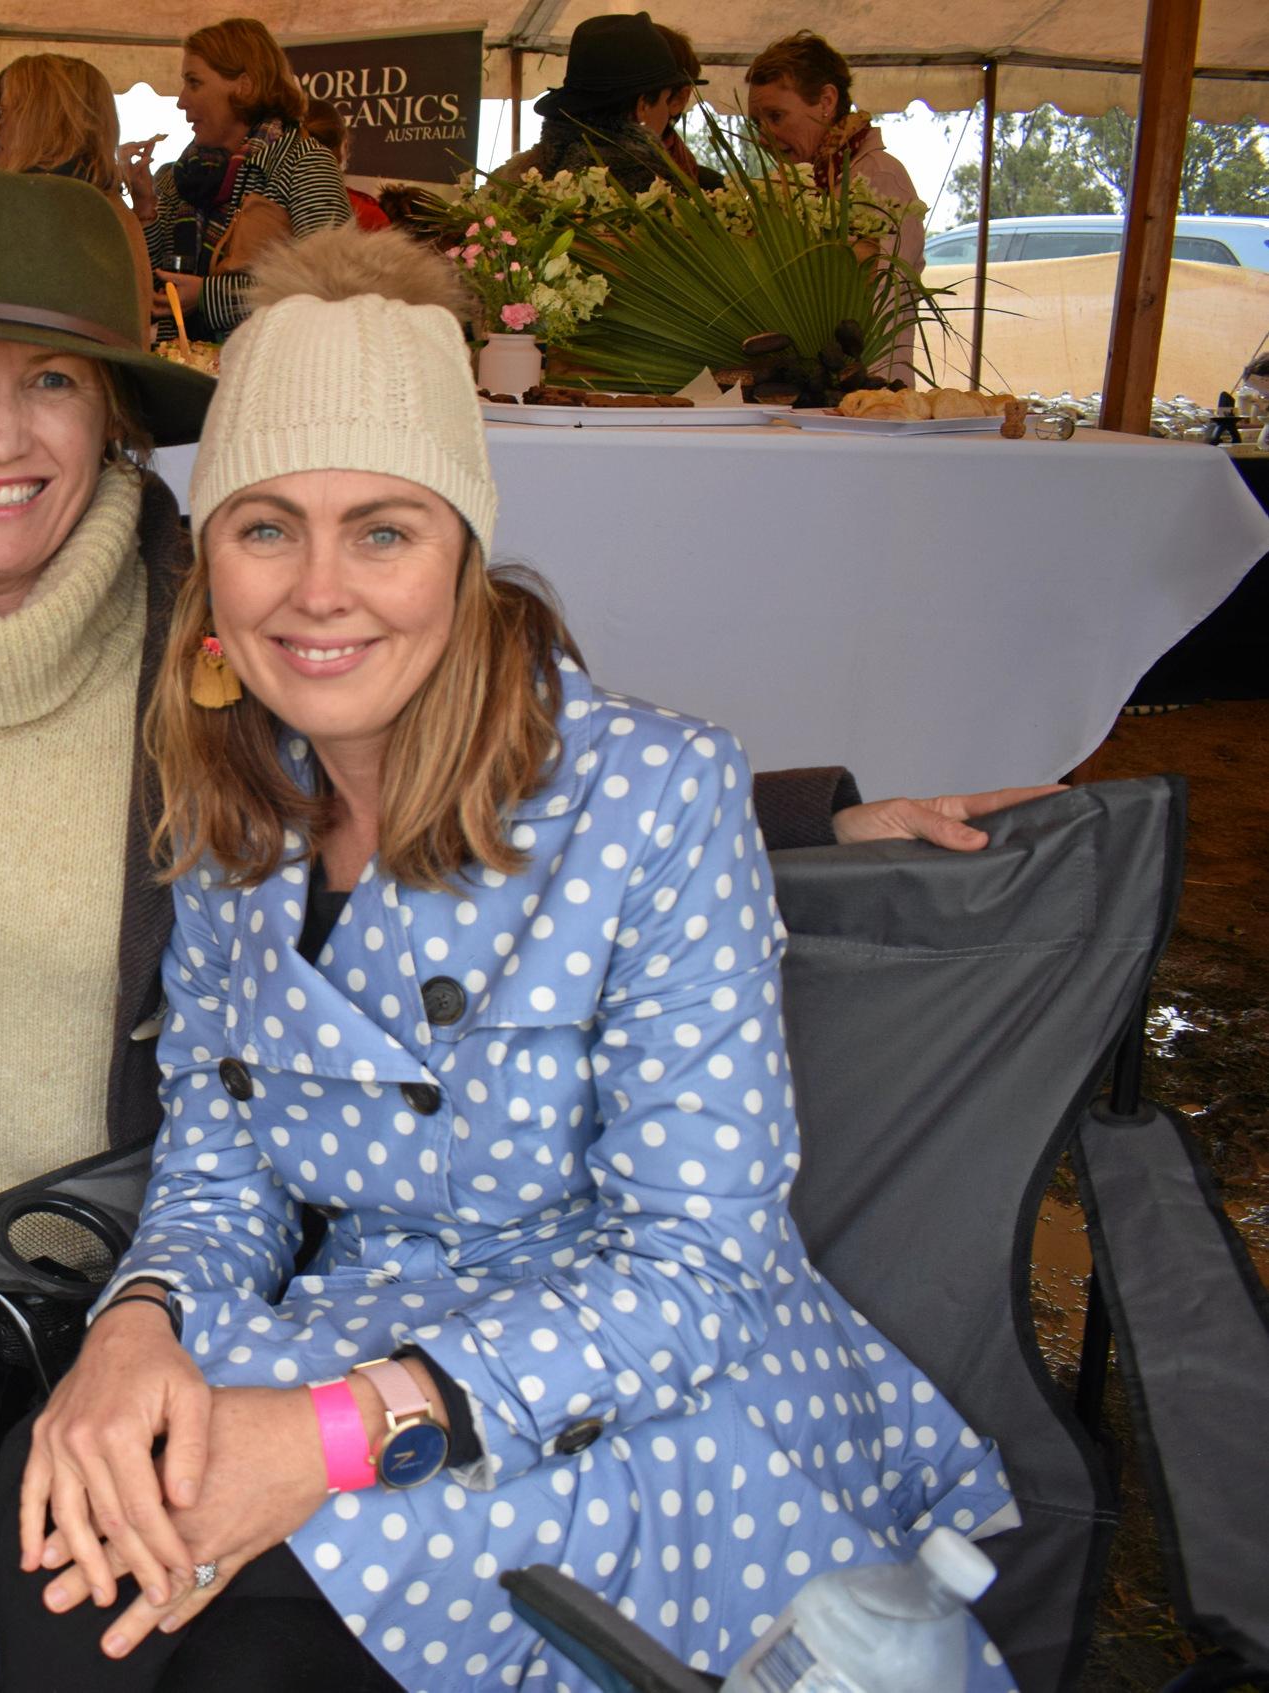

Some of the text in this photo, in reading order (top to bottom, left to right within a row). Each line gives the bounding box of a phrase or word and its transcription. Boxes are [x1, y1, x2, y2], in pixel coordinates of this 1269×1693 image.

[301, 66, 408, 100] ORLD
[333, 93, 460, 128] GANICS
[385, 125, 467, 143] AUSTRALIA
